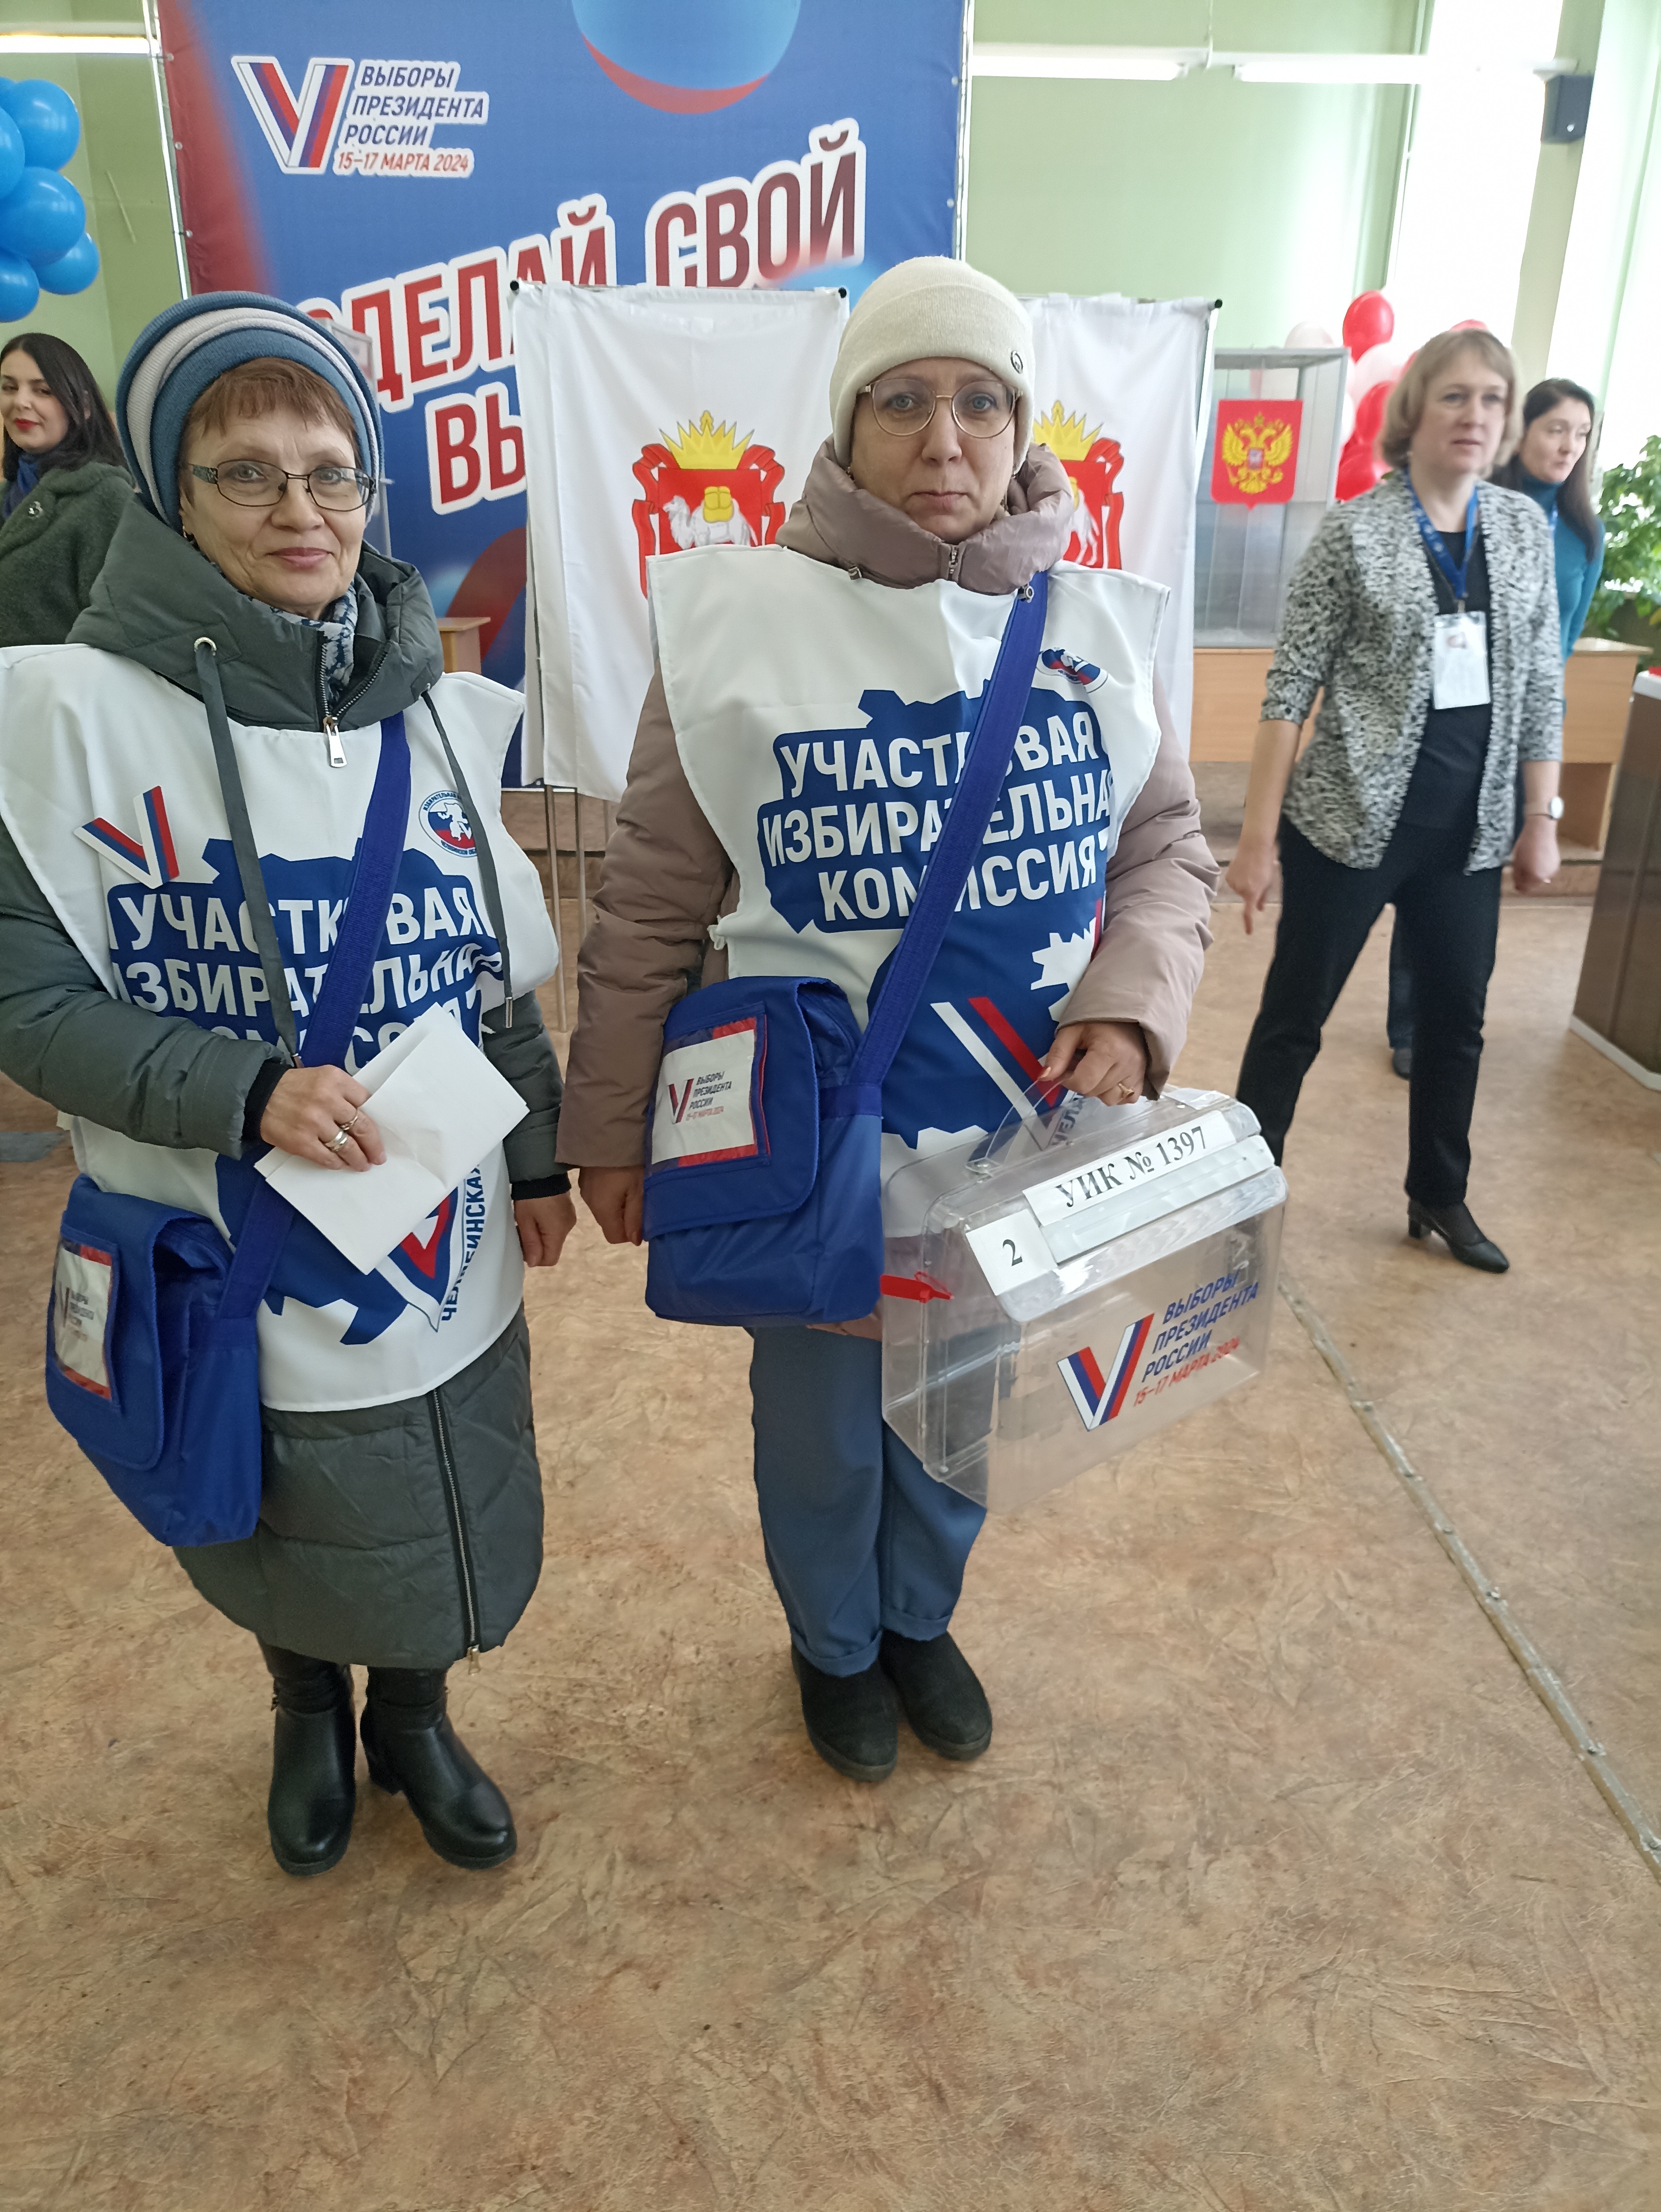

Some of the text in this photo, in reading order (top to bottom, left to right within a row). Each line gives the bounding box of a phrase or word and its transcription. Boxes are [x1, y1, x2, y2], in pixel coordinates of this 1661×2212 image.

[360, 65, 455, 88] ВЫБОРЫ
[344, 124, 428, 146] РОССИИ
[352, 95, 485, 120] ПРЕЗИДЕНТА
[380, 153, 431, 171] МАРТА
[432, 154, 469, 172] 2024
[307, 130, 856, 403] ДЕЛЙ СВОЙ
[779, 711, 1099, 798] УЧАСТВАЯ
[763, 769, 1113, 867] ИЗБИРАЕЛЬНА
[117, 887, 483, 954] УЧАСТКВАЯ
[1055, 1163, 1124, 1207] УИК
[1156, 1126, 1206, 1166] 1397
[1002, 1239, 1023, 1266] 2
[1152, 1282, 1259, 1354] ПРЕЗИДЕНТА
[1163, 1269, 1240, 1325] ВЫБОРЫ
[1141, 1329, 1213, 1383] РОССИИ
